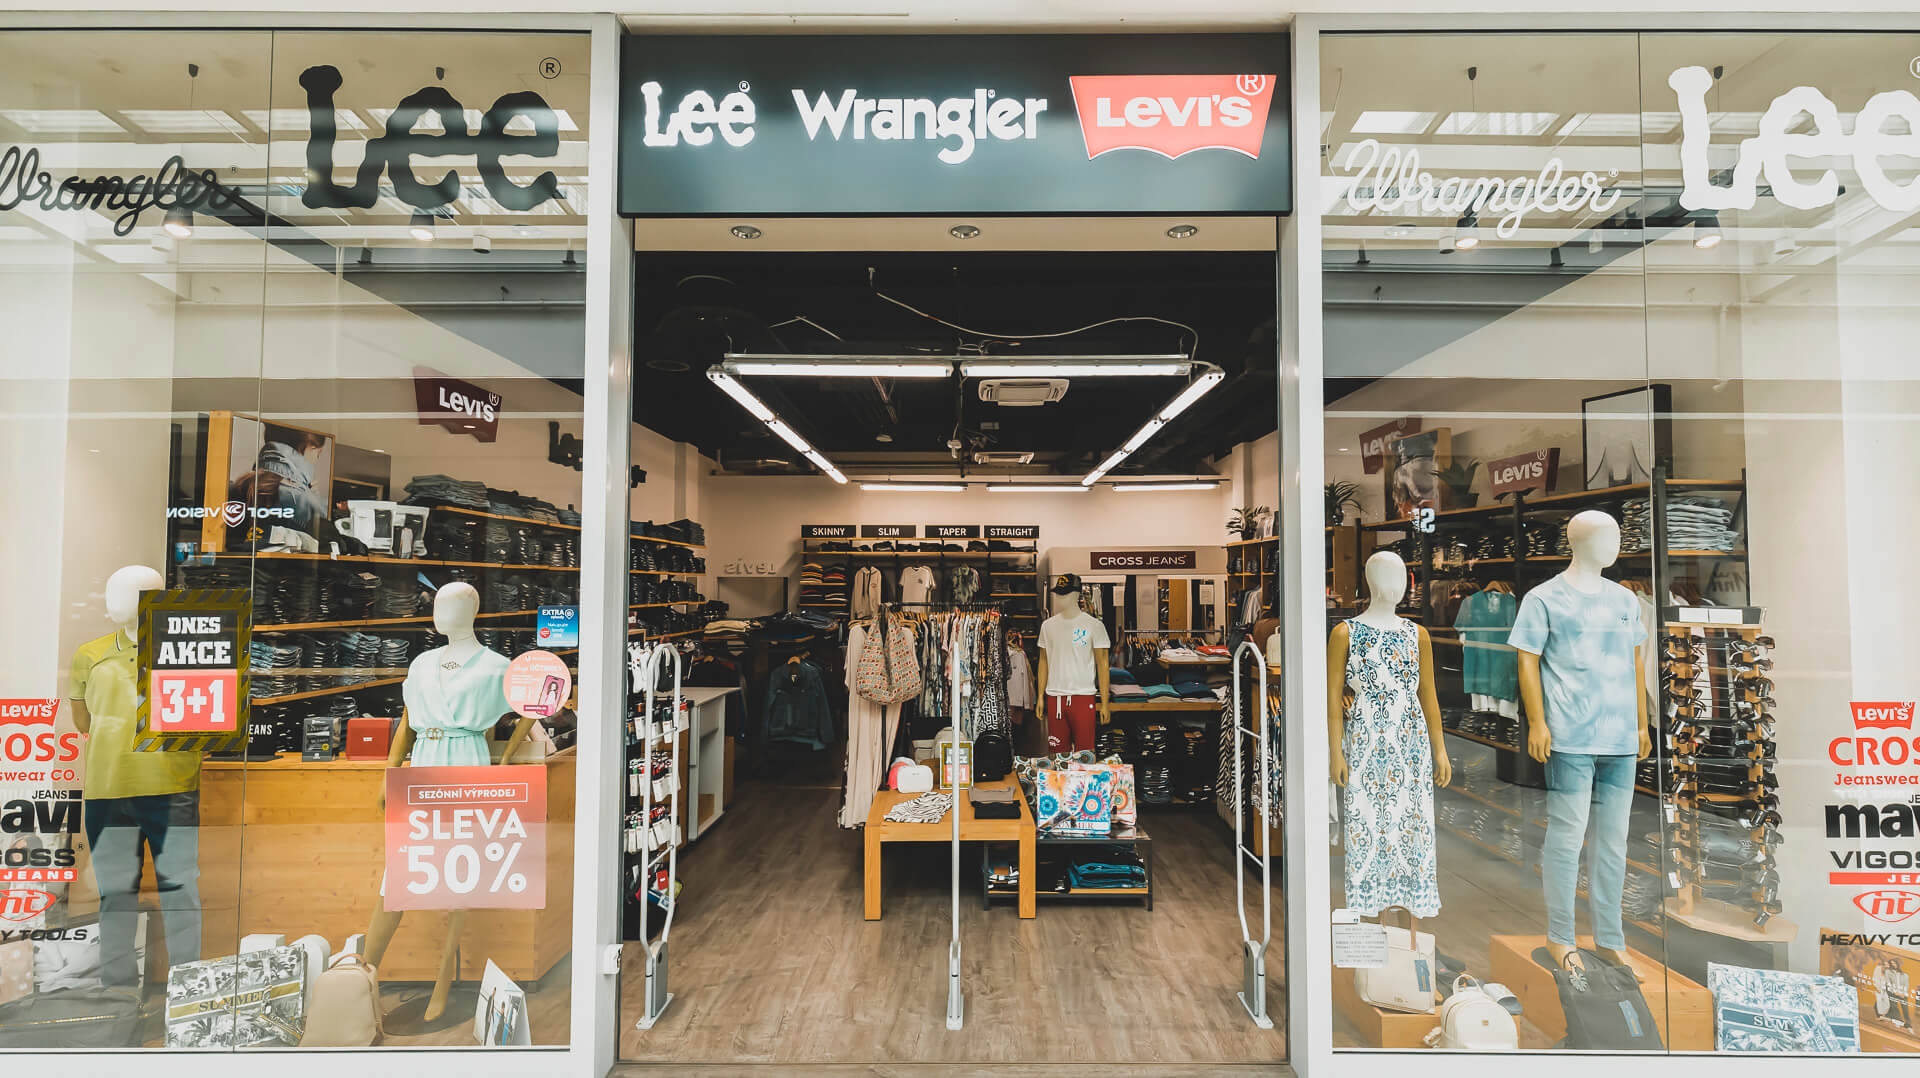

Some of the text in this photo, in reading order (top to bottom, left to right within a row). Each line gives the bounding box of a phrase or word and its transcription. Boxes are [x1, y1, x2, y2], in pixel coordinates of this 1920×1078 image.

[640, 81, 1048, 164] Lee Wrangler
[299, 65, 560, 211] Lee
[1668, 65, 1920, 212] Lee
[1344, 138, 1622, 239] Wrangler
[812, 527, 846, 536] SKINNY
[878, 527, 900, 536] SLIM
[938, 527, 967, 536] TAPER
[989, 527, 1034, 536] STRAIGHT
[1099, 556, 1186, 566] CROSS JEANS
[168, 616, 221, 634] DNES
[157, 641, 232, 665] AKCE
[160, 679, 225, 723] 3+1
[248, 724, 273, 736] EANS
[0, 732, 80, 762] OSS
[32, 790, 67, 800] JEANS
[464, 786, 516, 799] VÝPRODEJ
[0, 799, 81, 834] avi
[408, 808, 528, 841] SLEVA
[0, 848, 75, 867] OSS
[4, 871, 74, 880] JEANS
[407, 842, 527, 895] 50%
[19, 928, 88, 942] TOOLS
[1820, 933, 1892, 946] HEAVY
